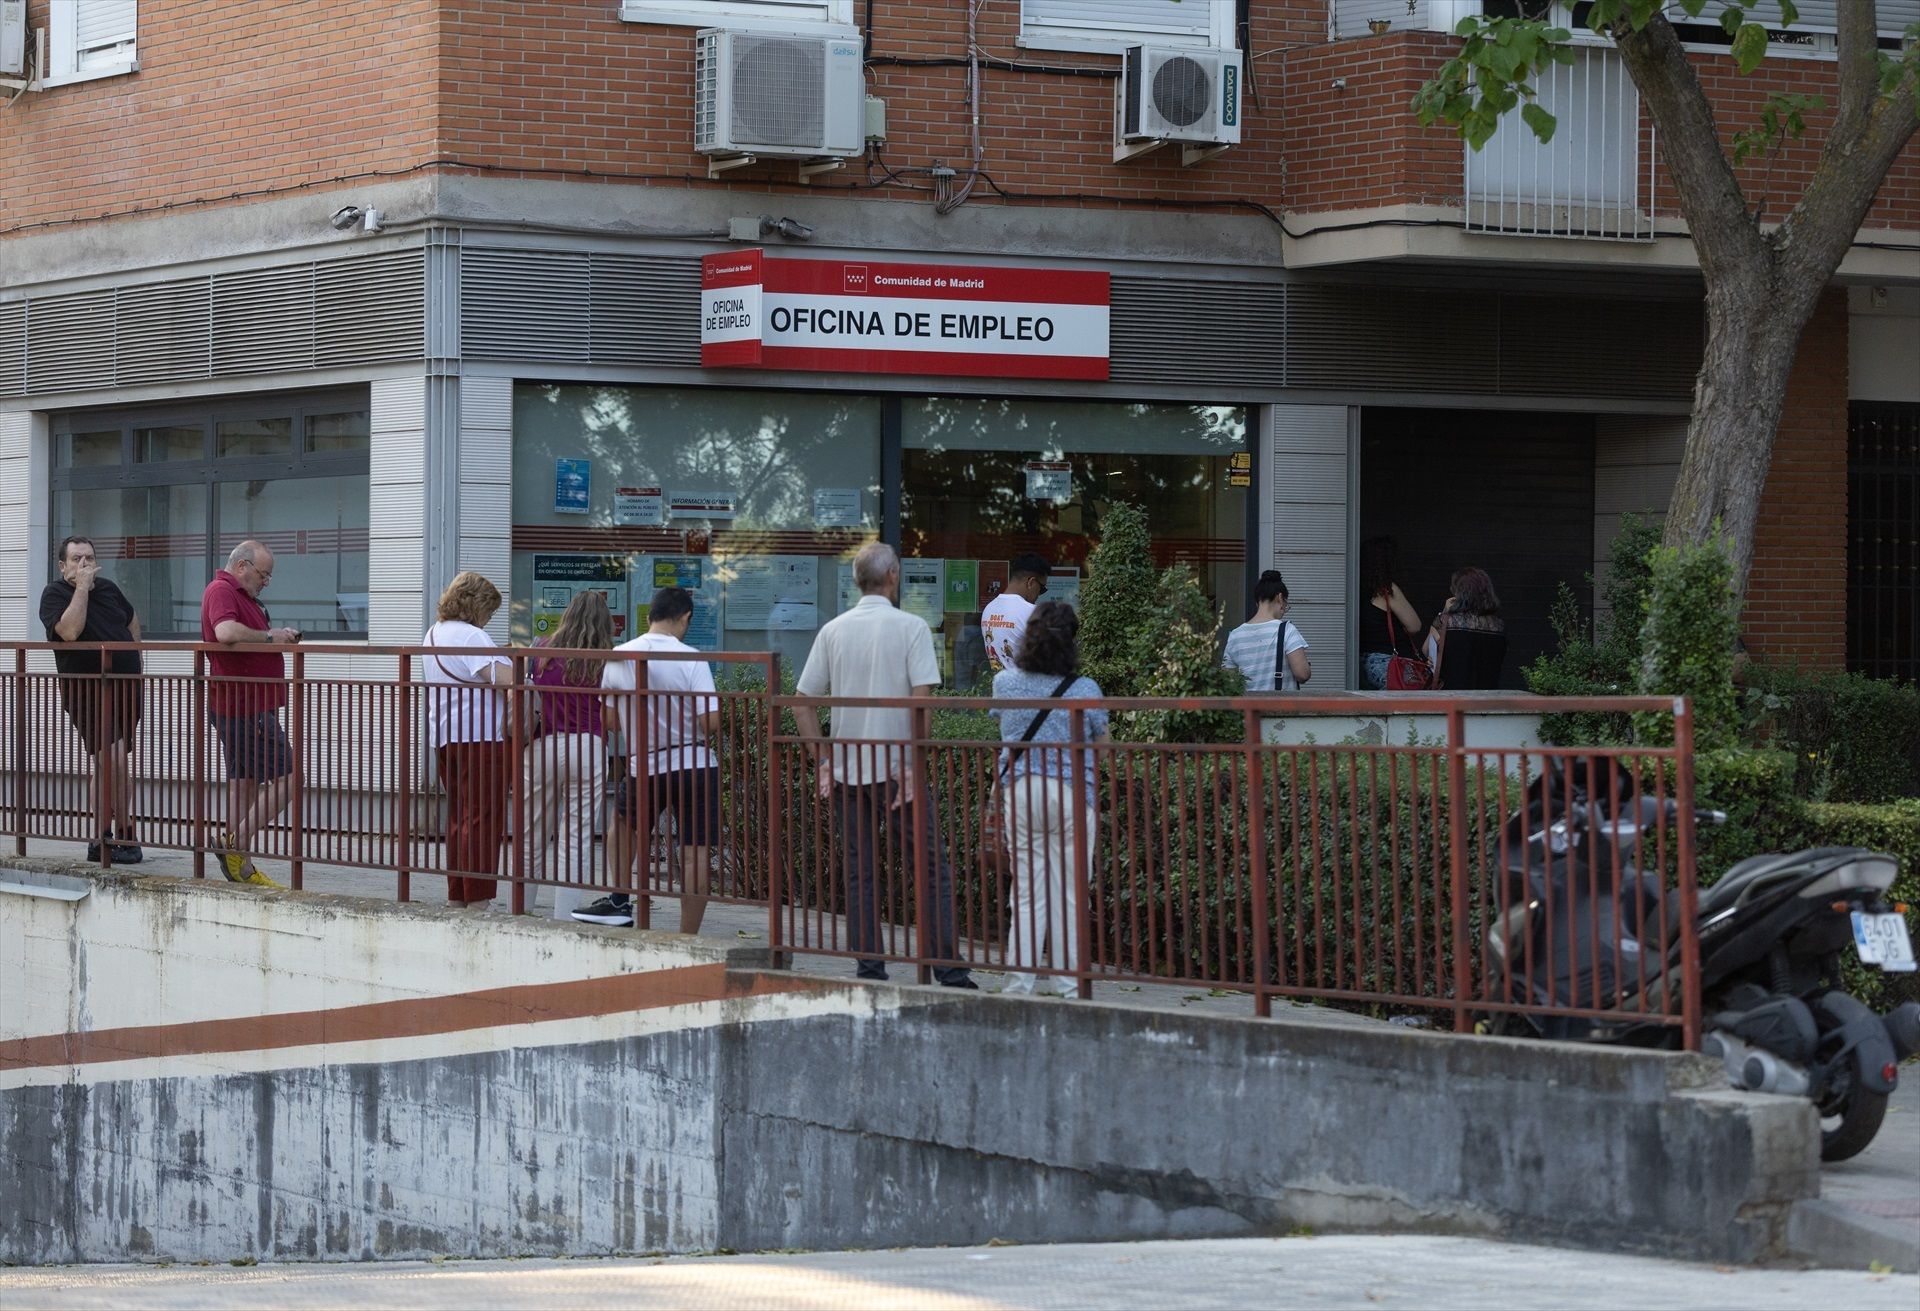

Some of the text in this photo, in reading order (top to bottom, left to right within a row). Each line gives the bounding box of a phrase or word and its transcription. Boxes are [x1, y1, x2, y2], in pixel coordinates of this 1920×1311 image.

[1226, 68, 1234, 123] DAEWOO
[715, 266, 735, 274] Comunidad
[874, 275, 984, 288] Comunidad de Madrid
[713, 299, 744, 314] OFICINA
[706, 314, 751, 330] DE EMPLEO
[770, 307, 1054, 342] OFICINA DE EMPLEO
